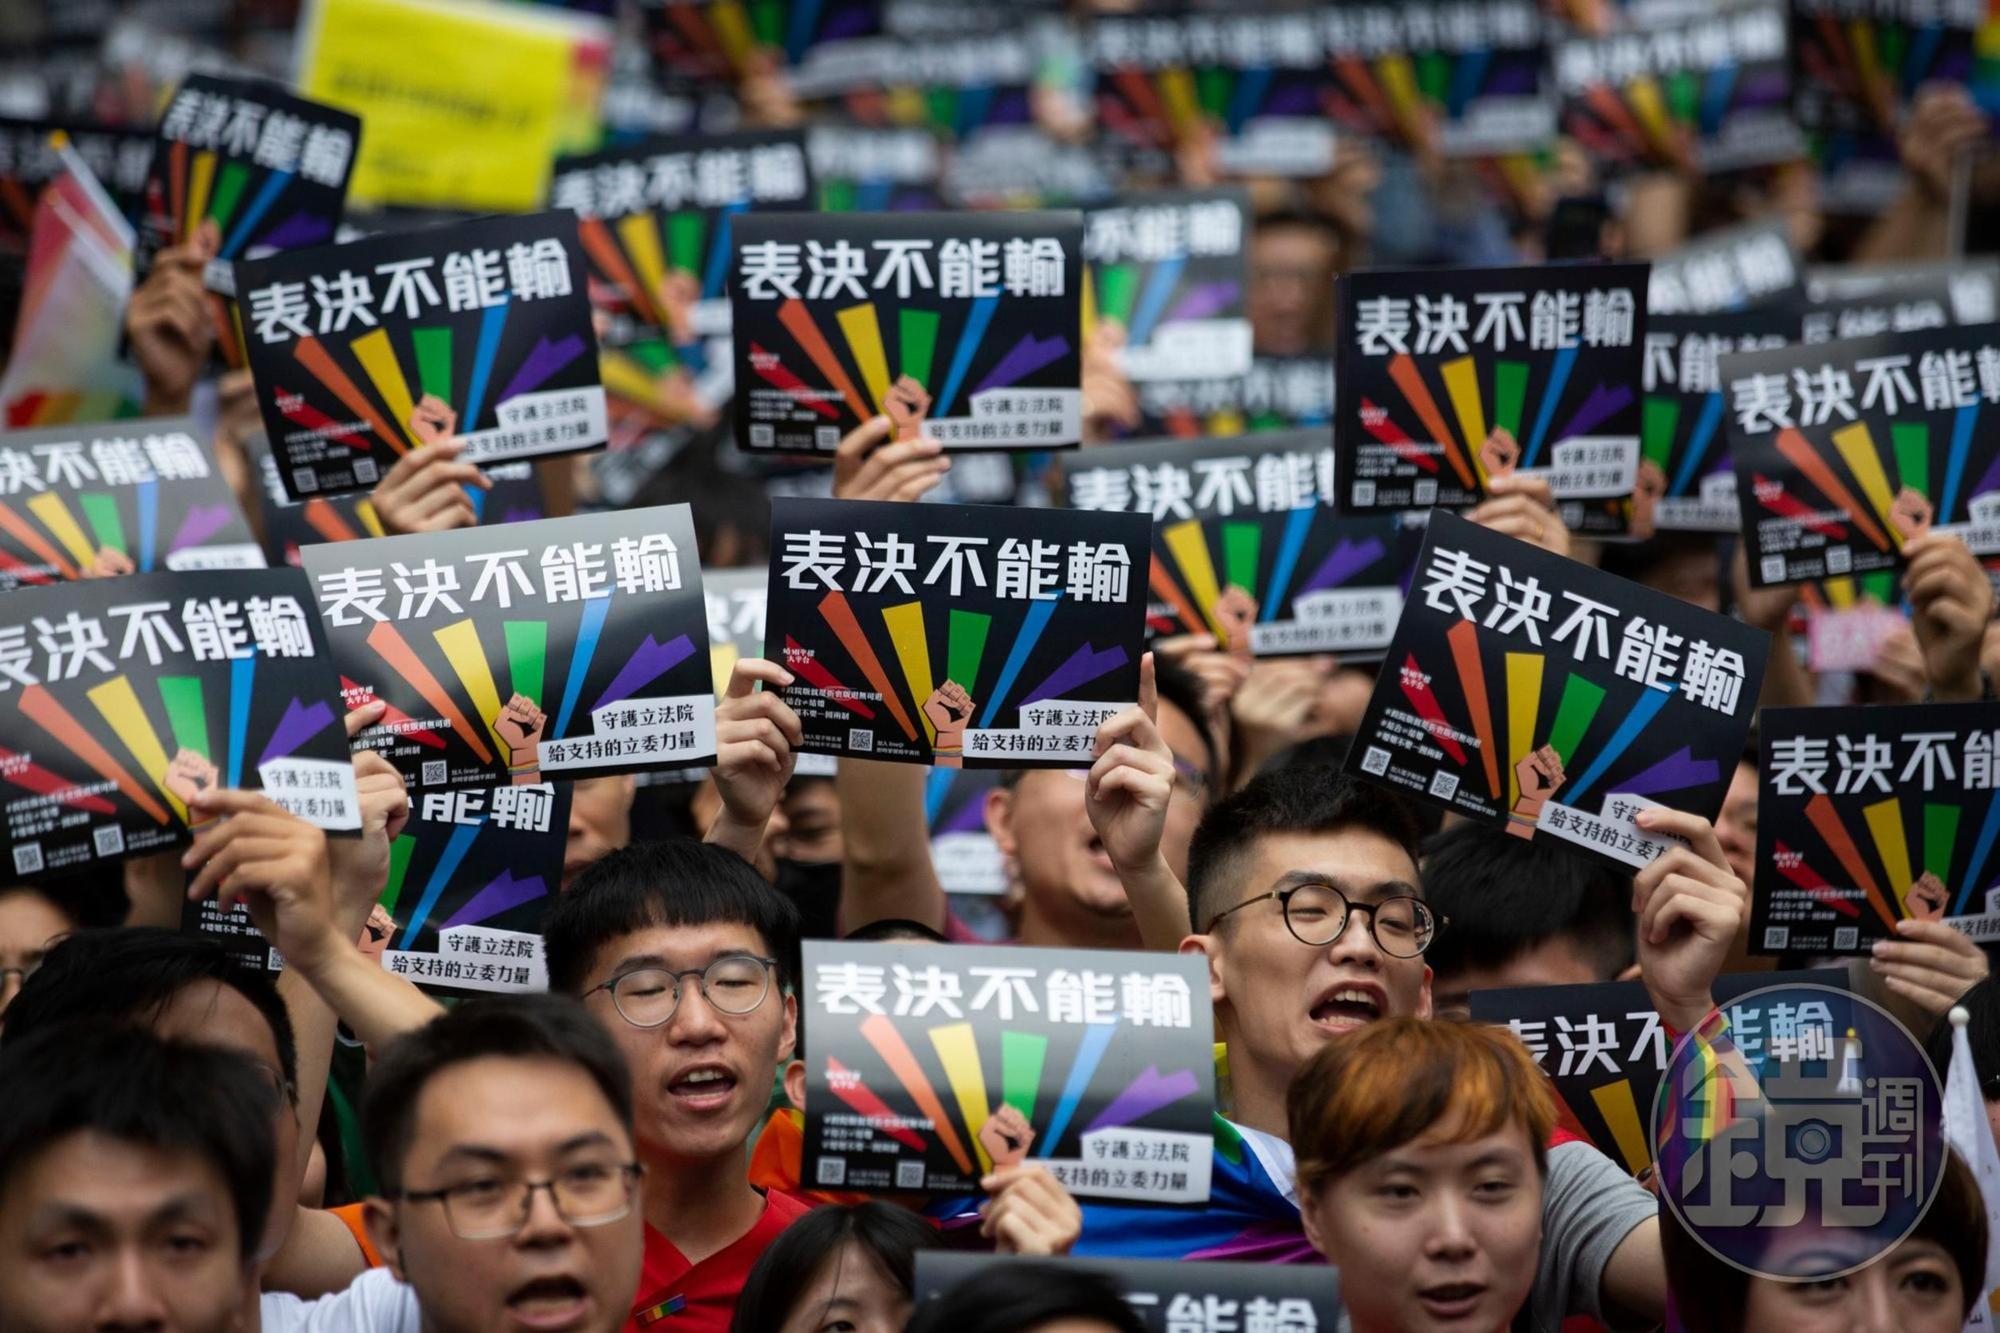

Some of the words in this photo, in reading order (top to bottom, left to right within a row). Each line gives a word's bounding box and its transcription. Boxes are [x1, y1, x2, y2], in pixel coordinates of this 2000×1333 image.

[161, 86, 353, 188] 表決不能輸
[249, 236, 572, 344] 表決不能輸
[739, 237, 1066, 300] 表決不能輸
[1354, 287, 1635, 355] 表決不能輸
[1642, 333, 1788, 393] 不能
[317, 533, 683, 628] 表決不能輸
[781, 529, 1131, 603] 表決不能輸
[1422, 546, 1746, 716] 表決不能輸
[601, 703, 695, 730] 守護立法院
[548, 731, 697, 764] 給支持的立委力量
[269, 770, 342, 789] 守護立法院
[391, 954, 531, 985] 給支持的立委力量
[448, 934, 535, 959] 守護立法院
[816, 961, 1191, 1029] 表決不能輸
[1092, 1139, 1190, 1163] 守護立法院
[1124, 1293, 1318, 1333] 能輸
